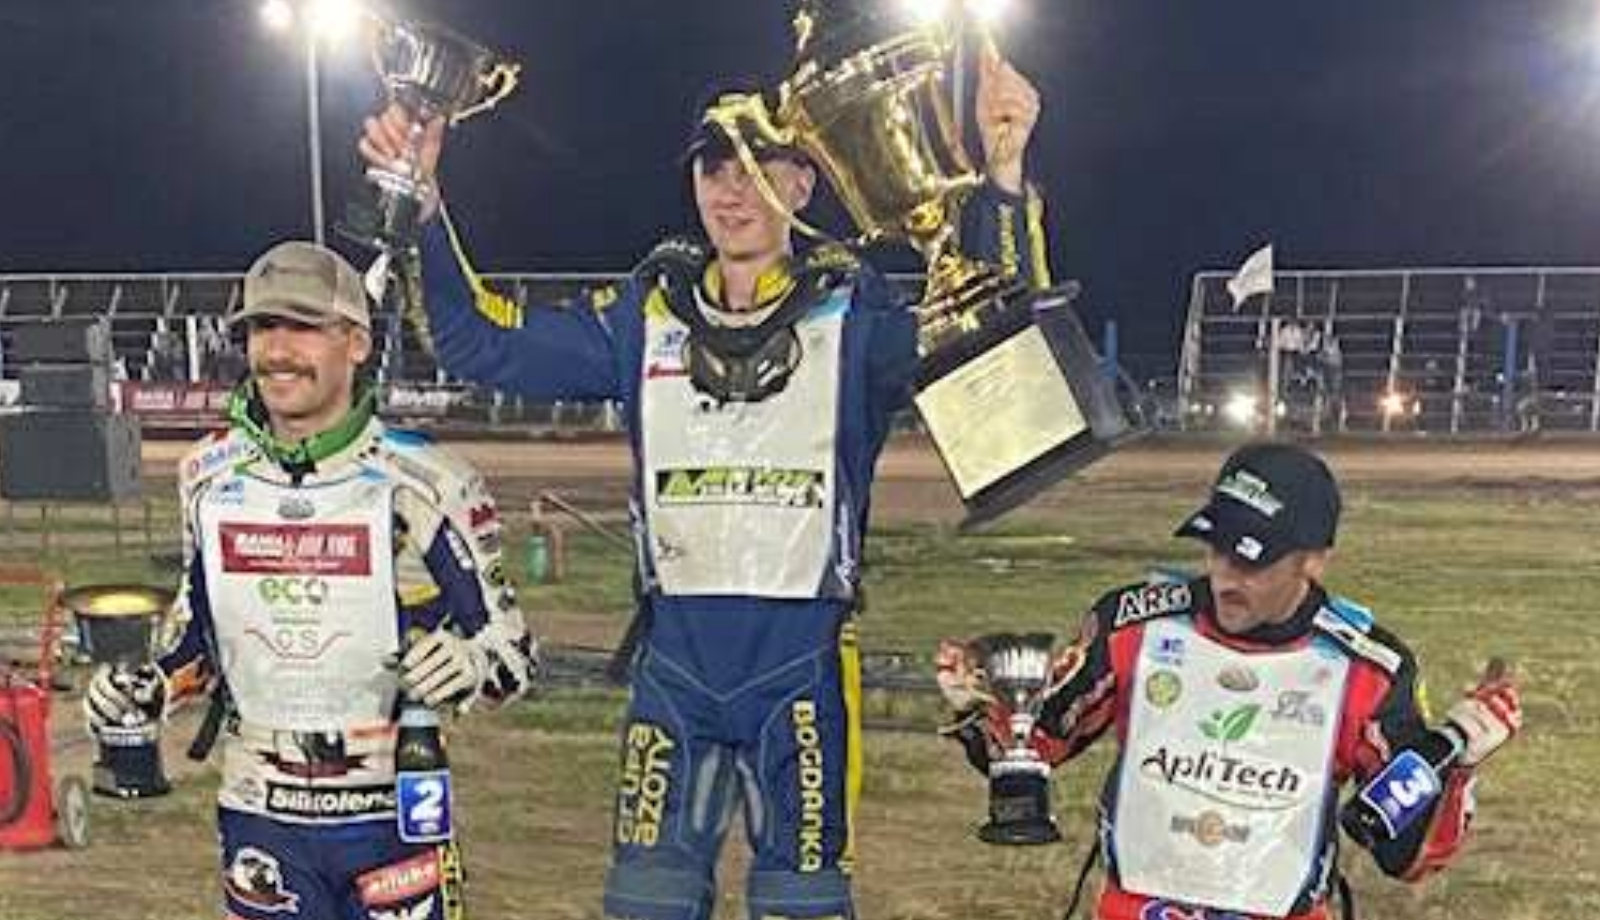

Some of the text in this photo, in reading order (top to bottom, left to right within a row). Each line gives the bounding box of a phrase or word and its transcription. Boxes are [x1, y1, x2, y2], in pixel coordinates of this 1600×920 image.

[259, 578, 328, 605] eco
[1142, 747, 1300, 792] ApliTech
[1389, 767, 1433, 807] 3
[410, 780, 443, 821] 2
